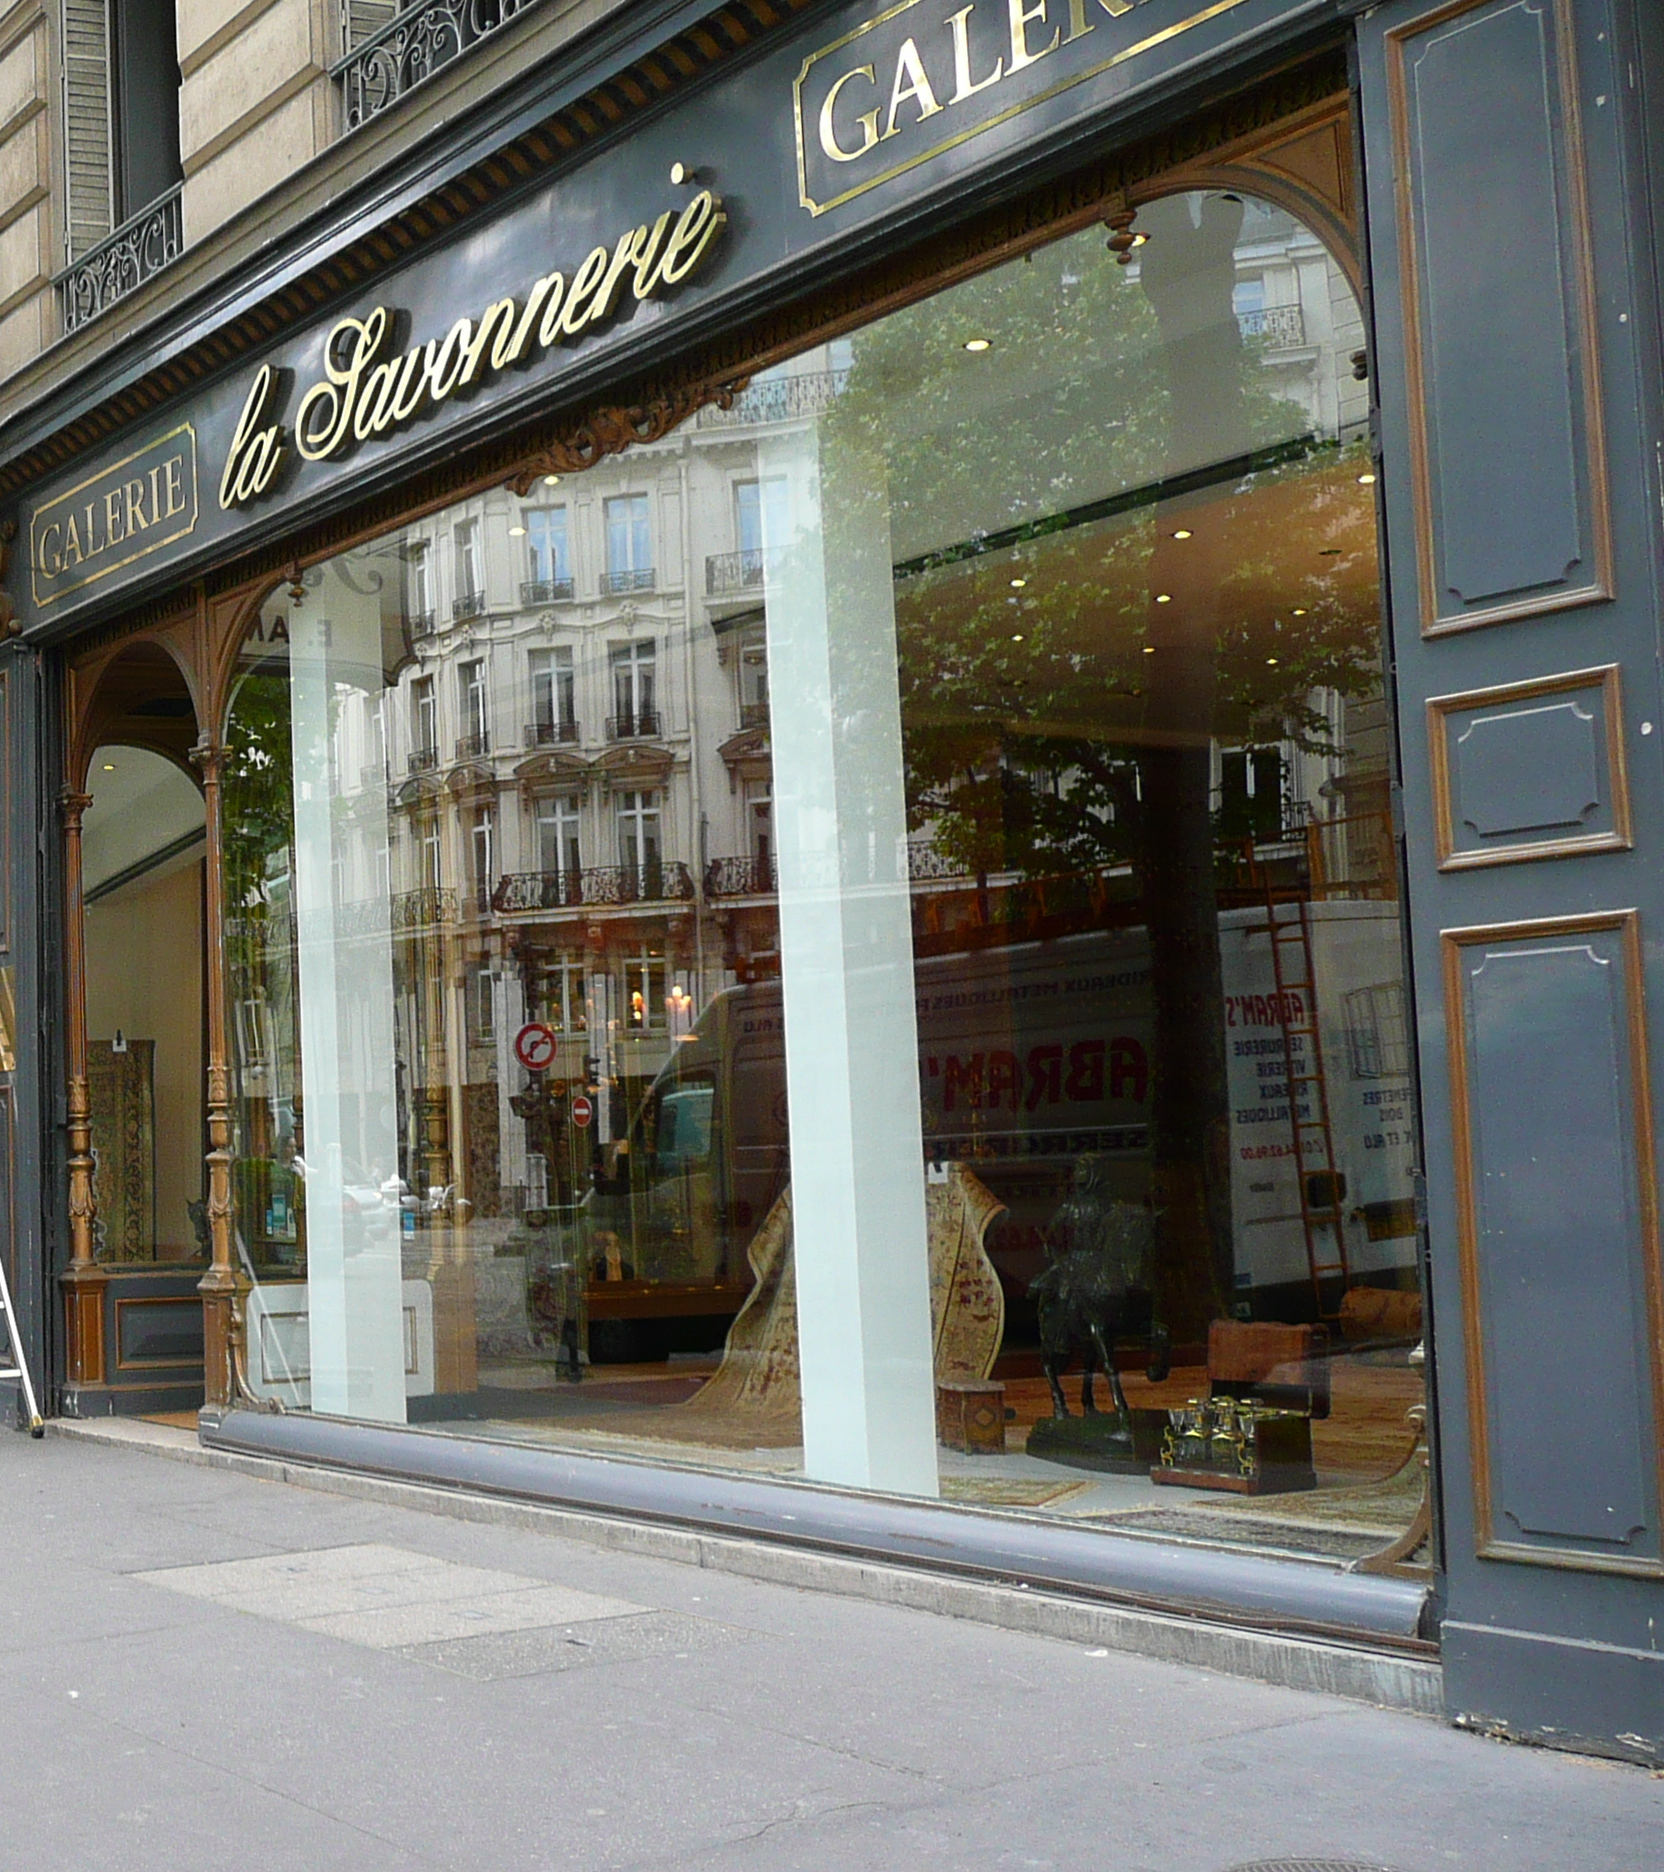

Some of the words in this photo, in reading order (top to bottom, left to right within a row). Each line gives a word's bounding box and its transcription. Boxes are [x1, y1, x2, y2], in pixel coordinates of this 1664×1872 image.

[218, 366, 280, 510] la
[295, 162, 727, 462] Savonnerie
[39, 454, 187, 581] GALERIE
